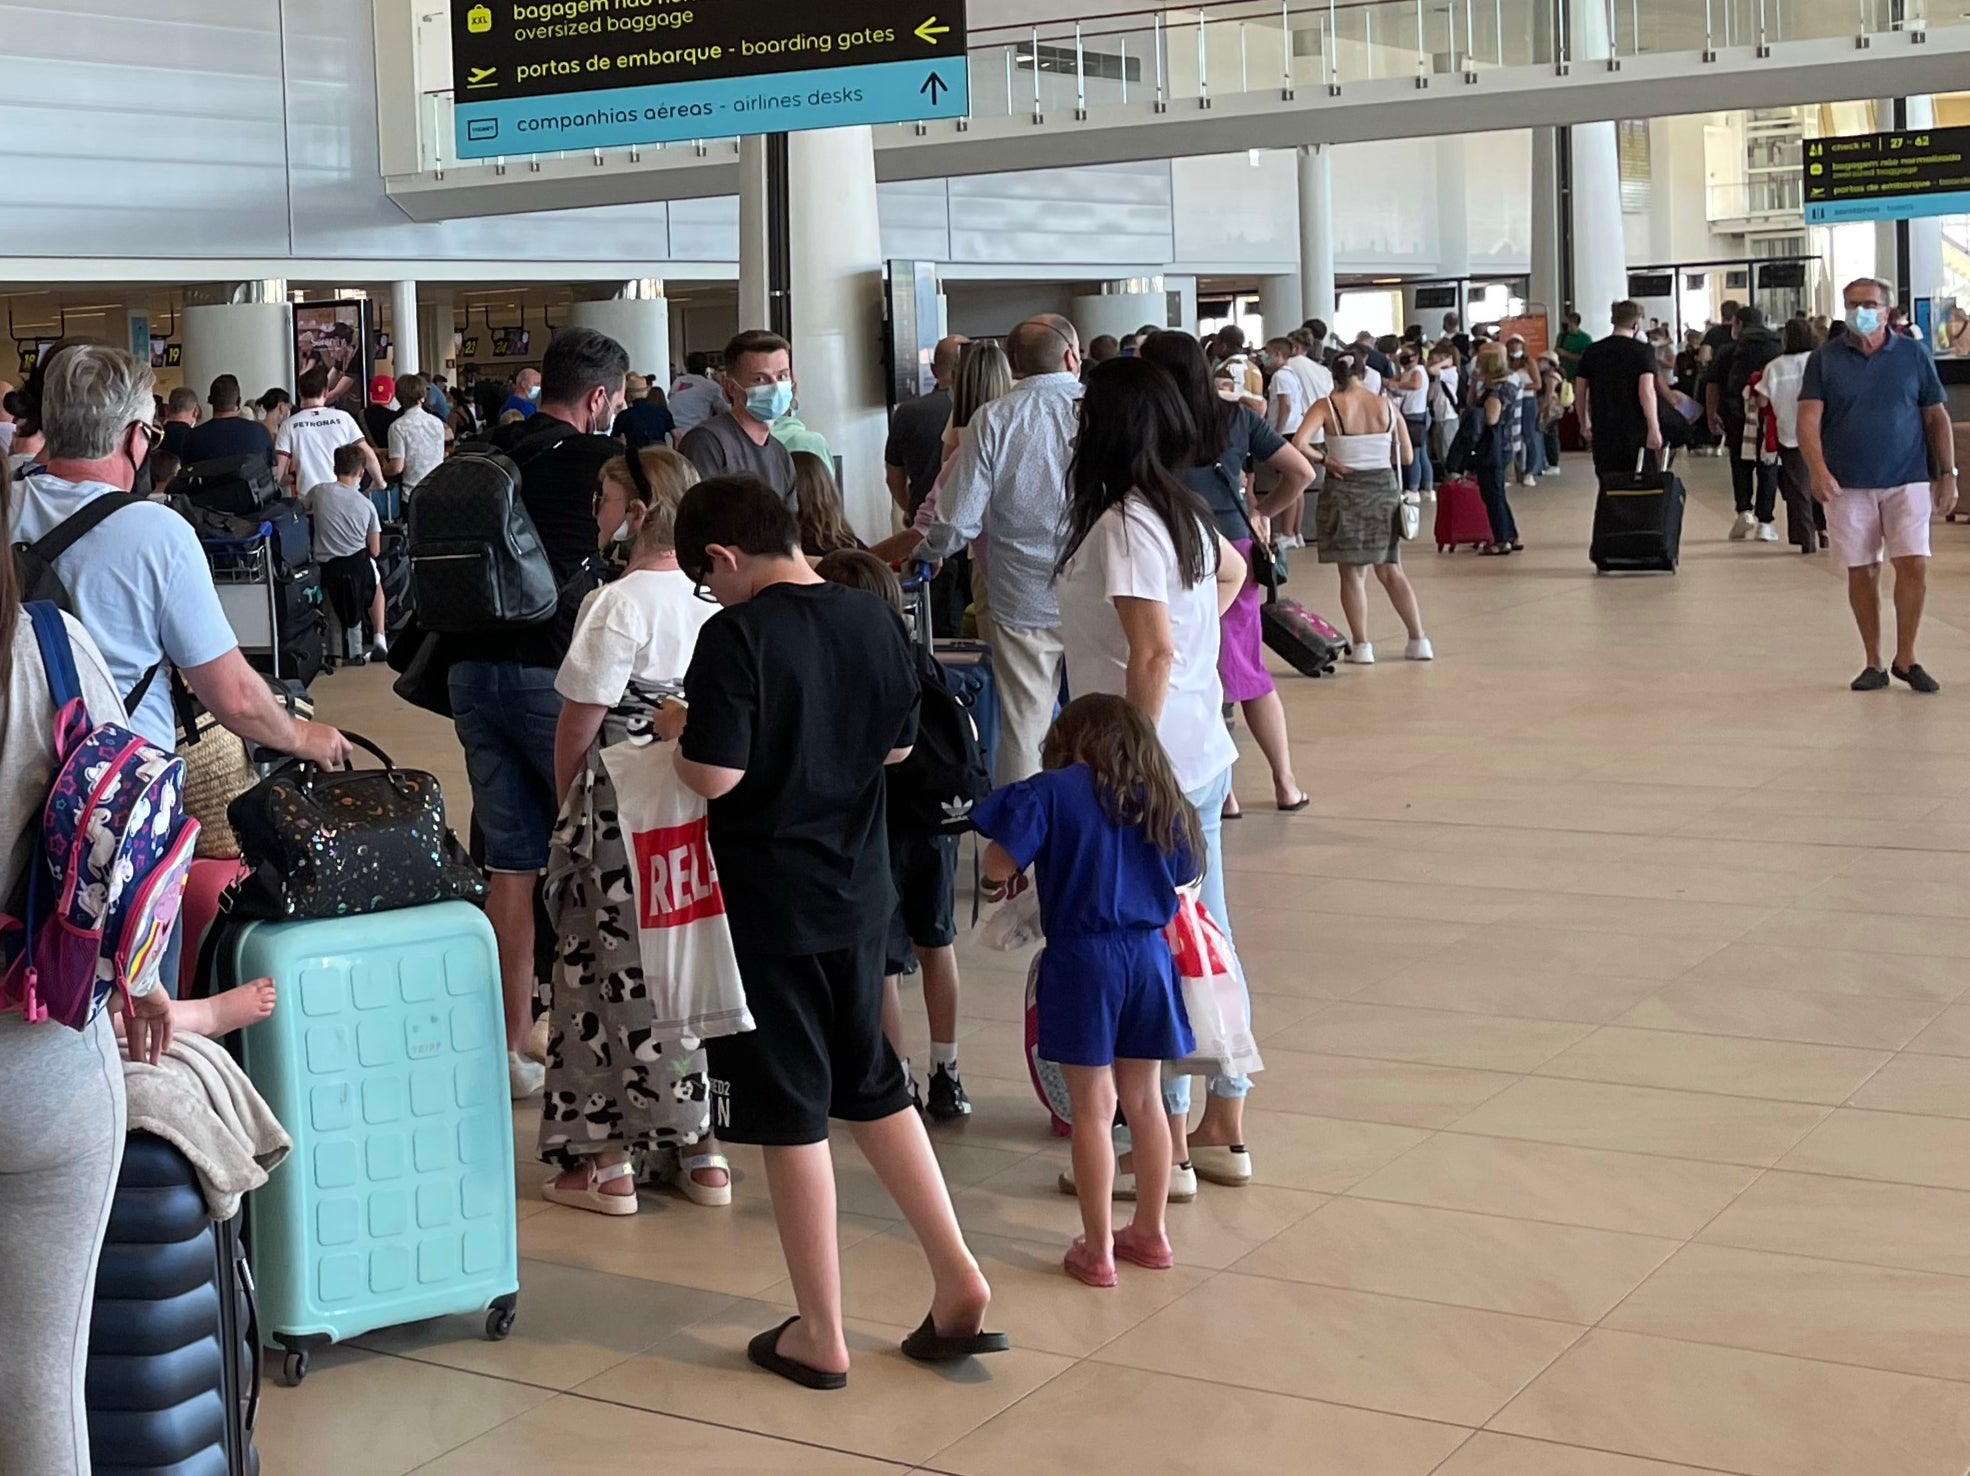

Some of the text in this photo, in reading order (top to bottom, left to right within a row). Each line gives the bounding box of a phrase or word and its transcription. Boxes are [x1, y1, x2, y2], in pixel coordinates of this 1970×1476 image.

[471, 16, 488, 24] XXL
[513, 0, 609, 21] bagagem
[515, 10, 694, 41] oversized baggage
[517, 60, 580, 82] portas
[586, 55, 611, 71] de
[617, 44, 721, 68] embarque
[741, 33, 831, 56] boarding
[837, 27, 895, 50] gates
[517, 108, 638, 132] companhias
[644, 102, 713, 119] aéreas
[733, 94, 801, 112] airlines
[807, 88, 863, 106] desks
[169, 347, 179, 362] 19
[293, 418, 341, 429] PETRONAS
